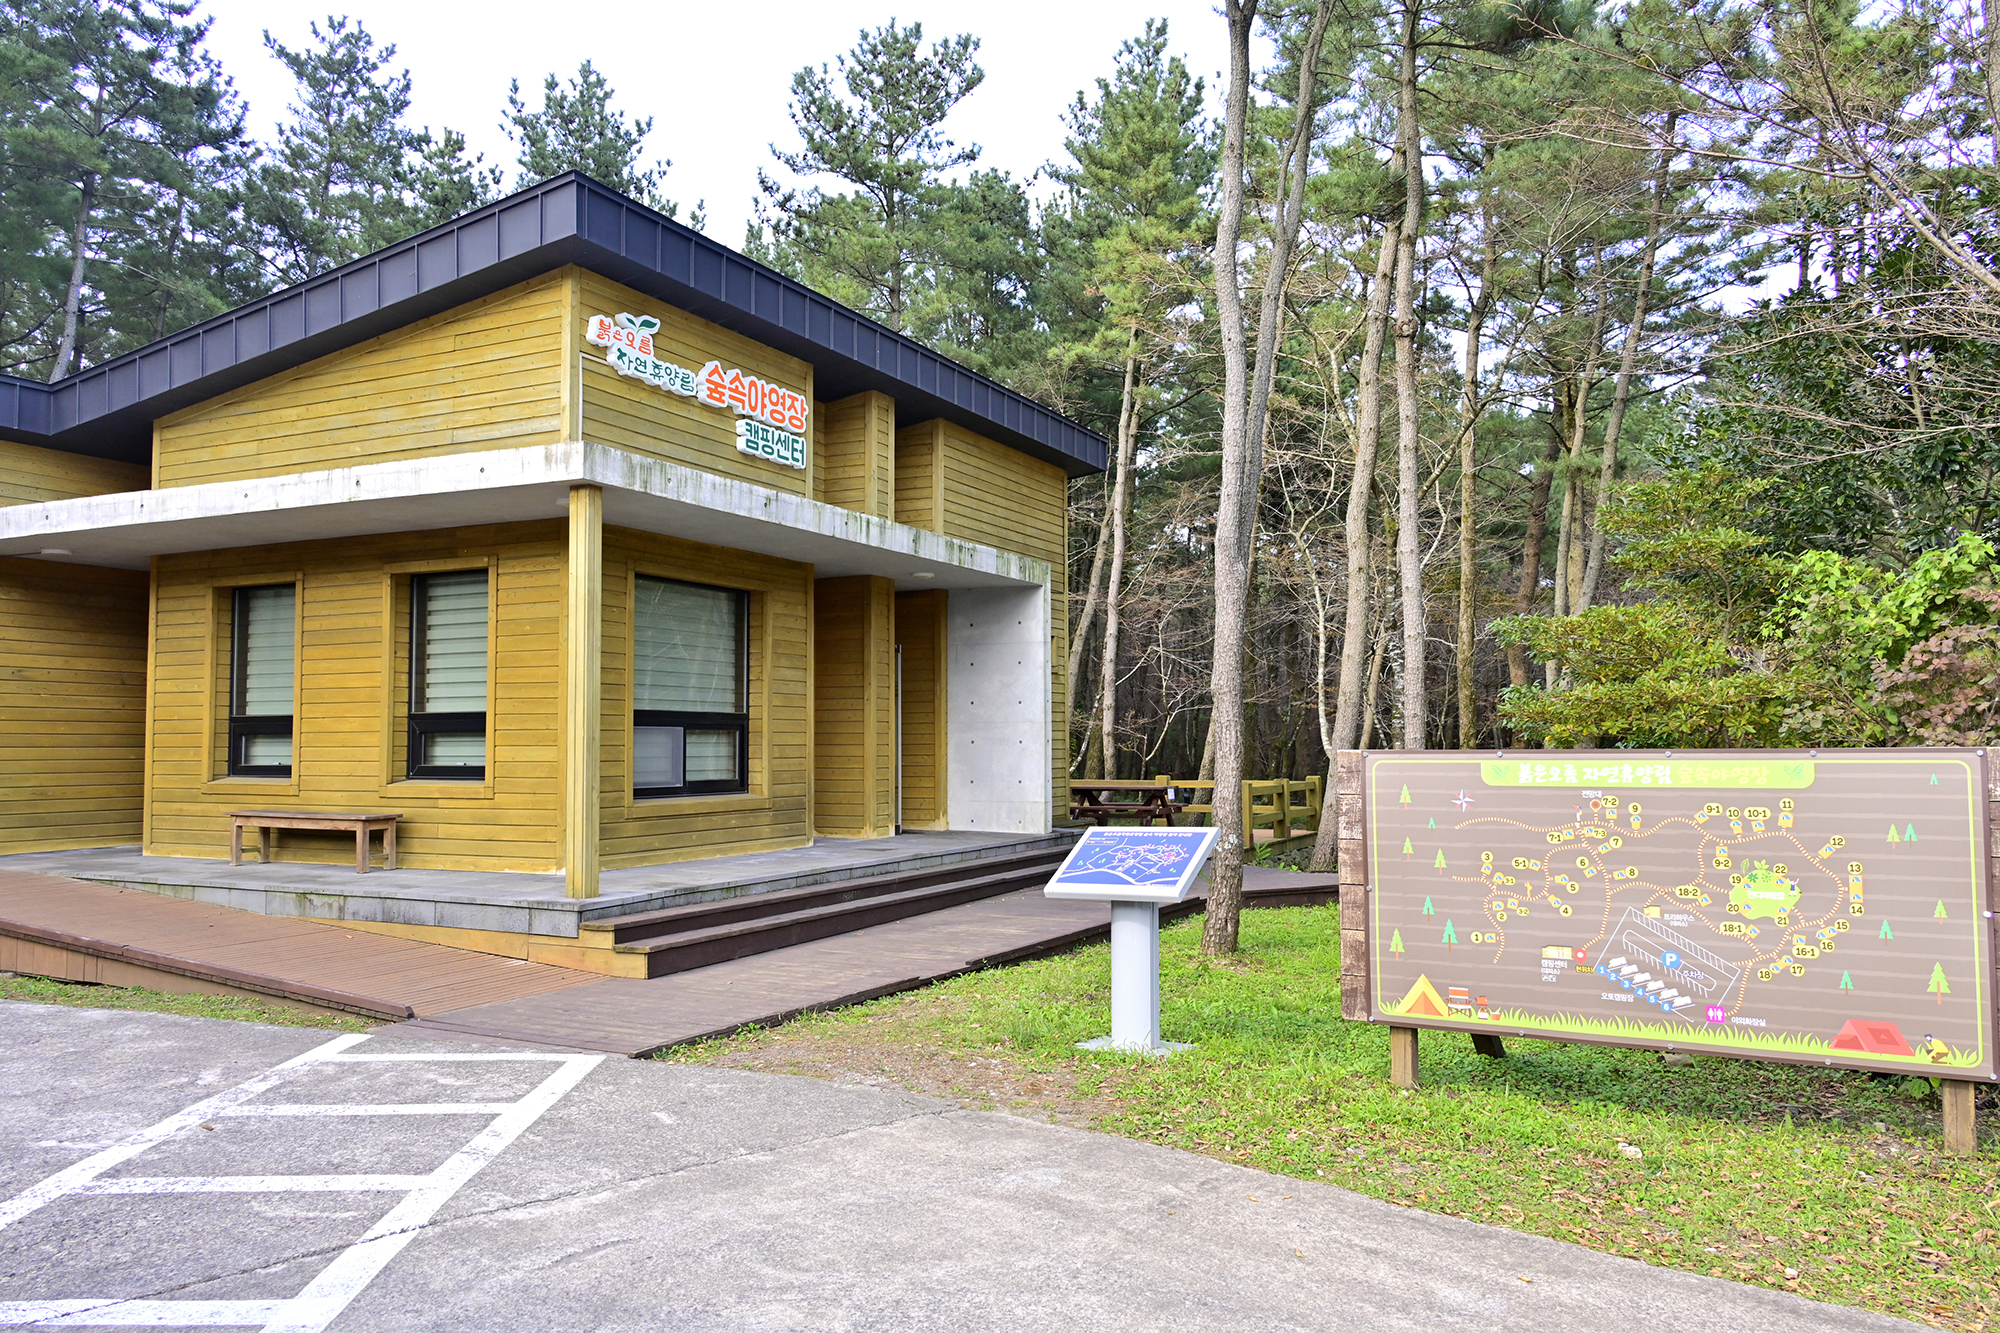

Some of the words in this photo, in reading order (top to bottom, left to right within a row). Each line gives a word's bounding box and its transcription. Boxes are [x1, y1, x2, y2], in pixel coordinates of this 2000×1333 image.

[617, 348, 694, 392] 자연휴양림
[705, 365, 806, 430] 숲속야영장
[745, 421, 805, 466] 캠핑센터
[1518, 763, 1578, 784] 붉은오름
[1582, 763, 1672, 785] 자연휴양림
[1678, 763, 1770, 785] 숲속야영장
[1602, 797, 1617, 806] 7-2
[1782, 801, 1792, 809] 11
[1632, 804, 1639, 813] 9
[1706, 805, 1720, 814] 9-1
[1728, 809, 1740, 818] 10
[1747, 809, 1767, 818] 10-1
[1548, 833, 1561, 842] 7-1
[1594, 829, 1606, 837] 7-3
[1613, 838, 1619, 846] 7
[1832, 837, 1844, 846] 12
[1484, 853, 1490, 861] 3
[1514, 860, 1527, 868] 5-1
[1580, 859, 1586, 867] 6
[1714, 859, 1730, 868] 9-2
[1629, 868, 1635, 876] 8
[1774, 865, 1786, 874] 22
[1849, 864, 1861, 872] 13
[1731, 875, 1742, 884] 19
[1570, 883, 1576, 892] 5
[1678, 888, 1698, 897] 18-2
[1563, 907, 1569, 915] 4
[1728, 904, 1740, 913] 20
[1851, 906, 1863, 914] 14
[1777, 917, 1788, 925] 21
[1723, 924, 1743, 933] 18-1
[1836, 922, 1848, 930] 15
[1822, 942, 1833, 951] 16
[1796, 948, 1816, 956] 16-1
[1665, 953, 1677, 966] P
[1792, 966, 1803, 974] 17
[1682, 970, 1705, 980] 주차장
[1759, 971, 1771, 979] 18
[1637, 988, 1643, 996] 4
[1600, 992, 1635, 1002] 오토캠핑장
[1663, 1003, 1670, 1011] 6
